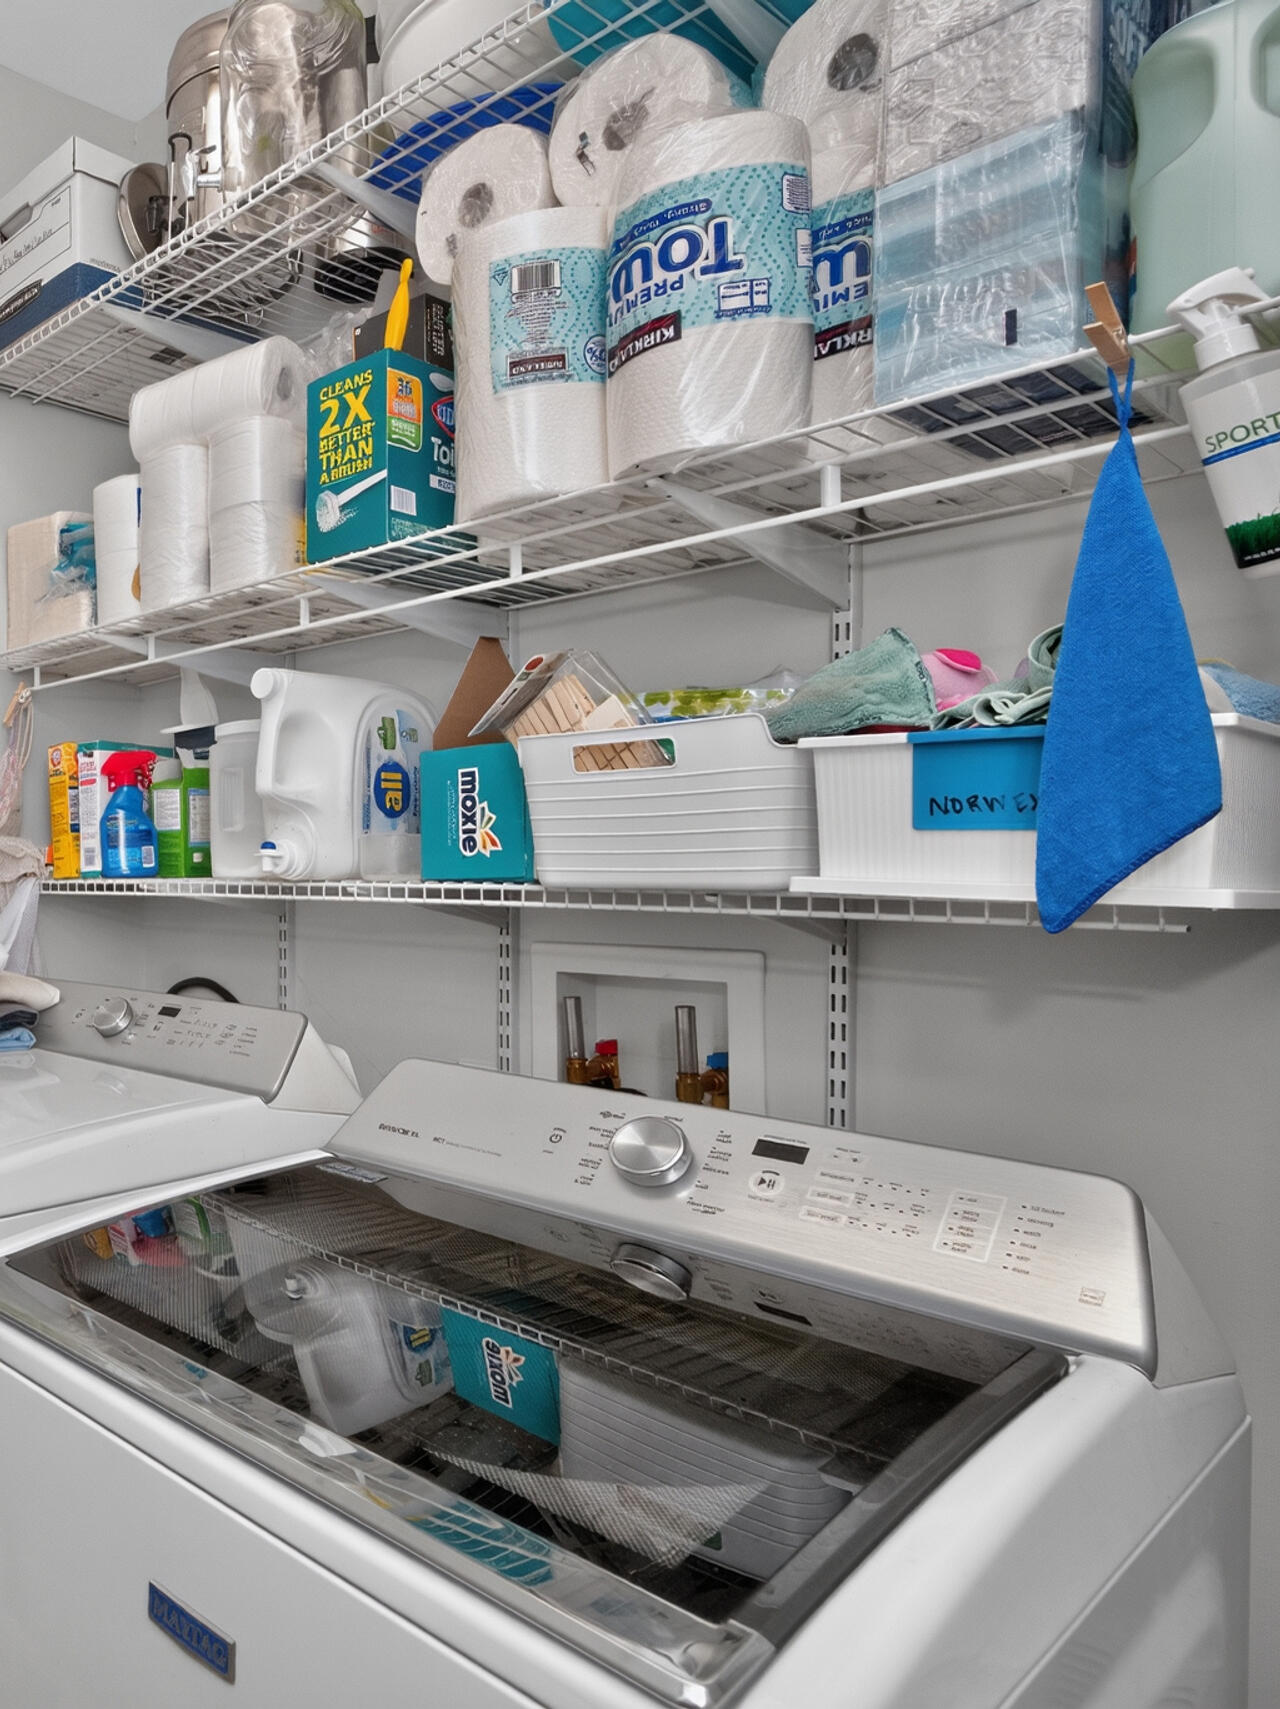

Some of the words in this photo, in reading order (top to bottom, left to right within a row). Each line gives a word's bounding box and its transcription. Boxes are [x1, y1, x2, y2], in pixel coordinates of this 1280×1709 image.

[320, 369, 373, 401] CLEANS
[320, 385, 373, 438] 2X
[1205, 411, 1280, 453] SPORT
[320, 438, 373, 471] THAN
[320, 472, 329, 485] A
[381, 771, 403, 812] all
[460, 769, 478, 854] moxie
[152, 1593, 227, 1668] MAYTAG
